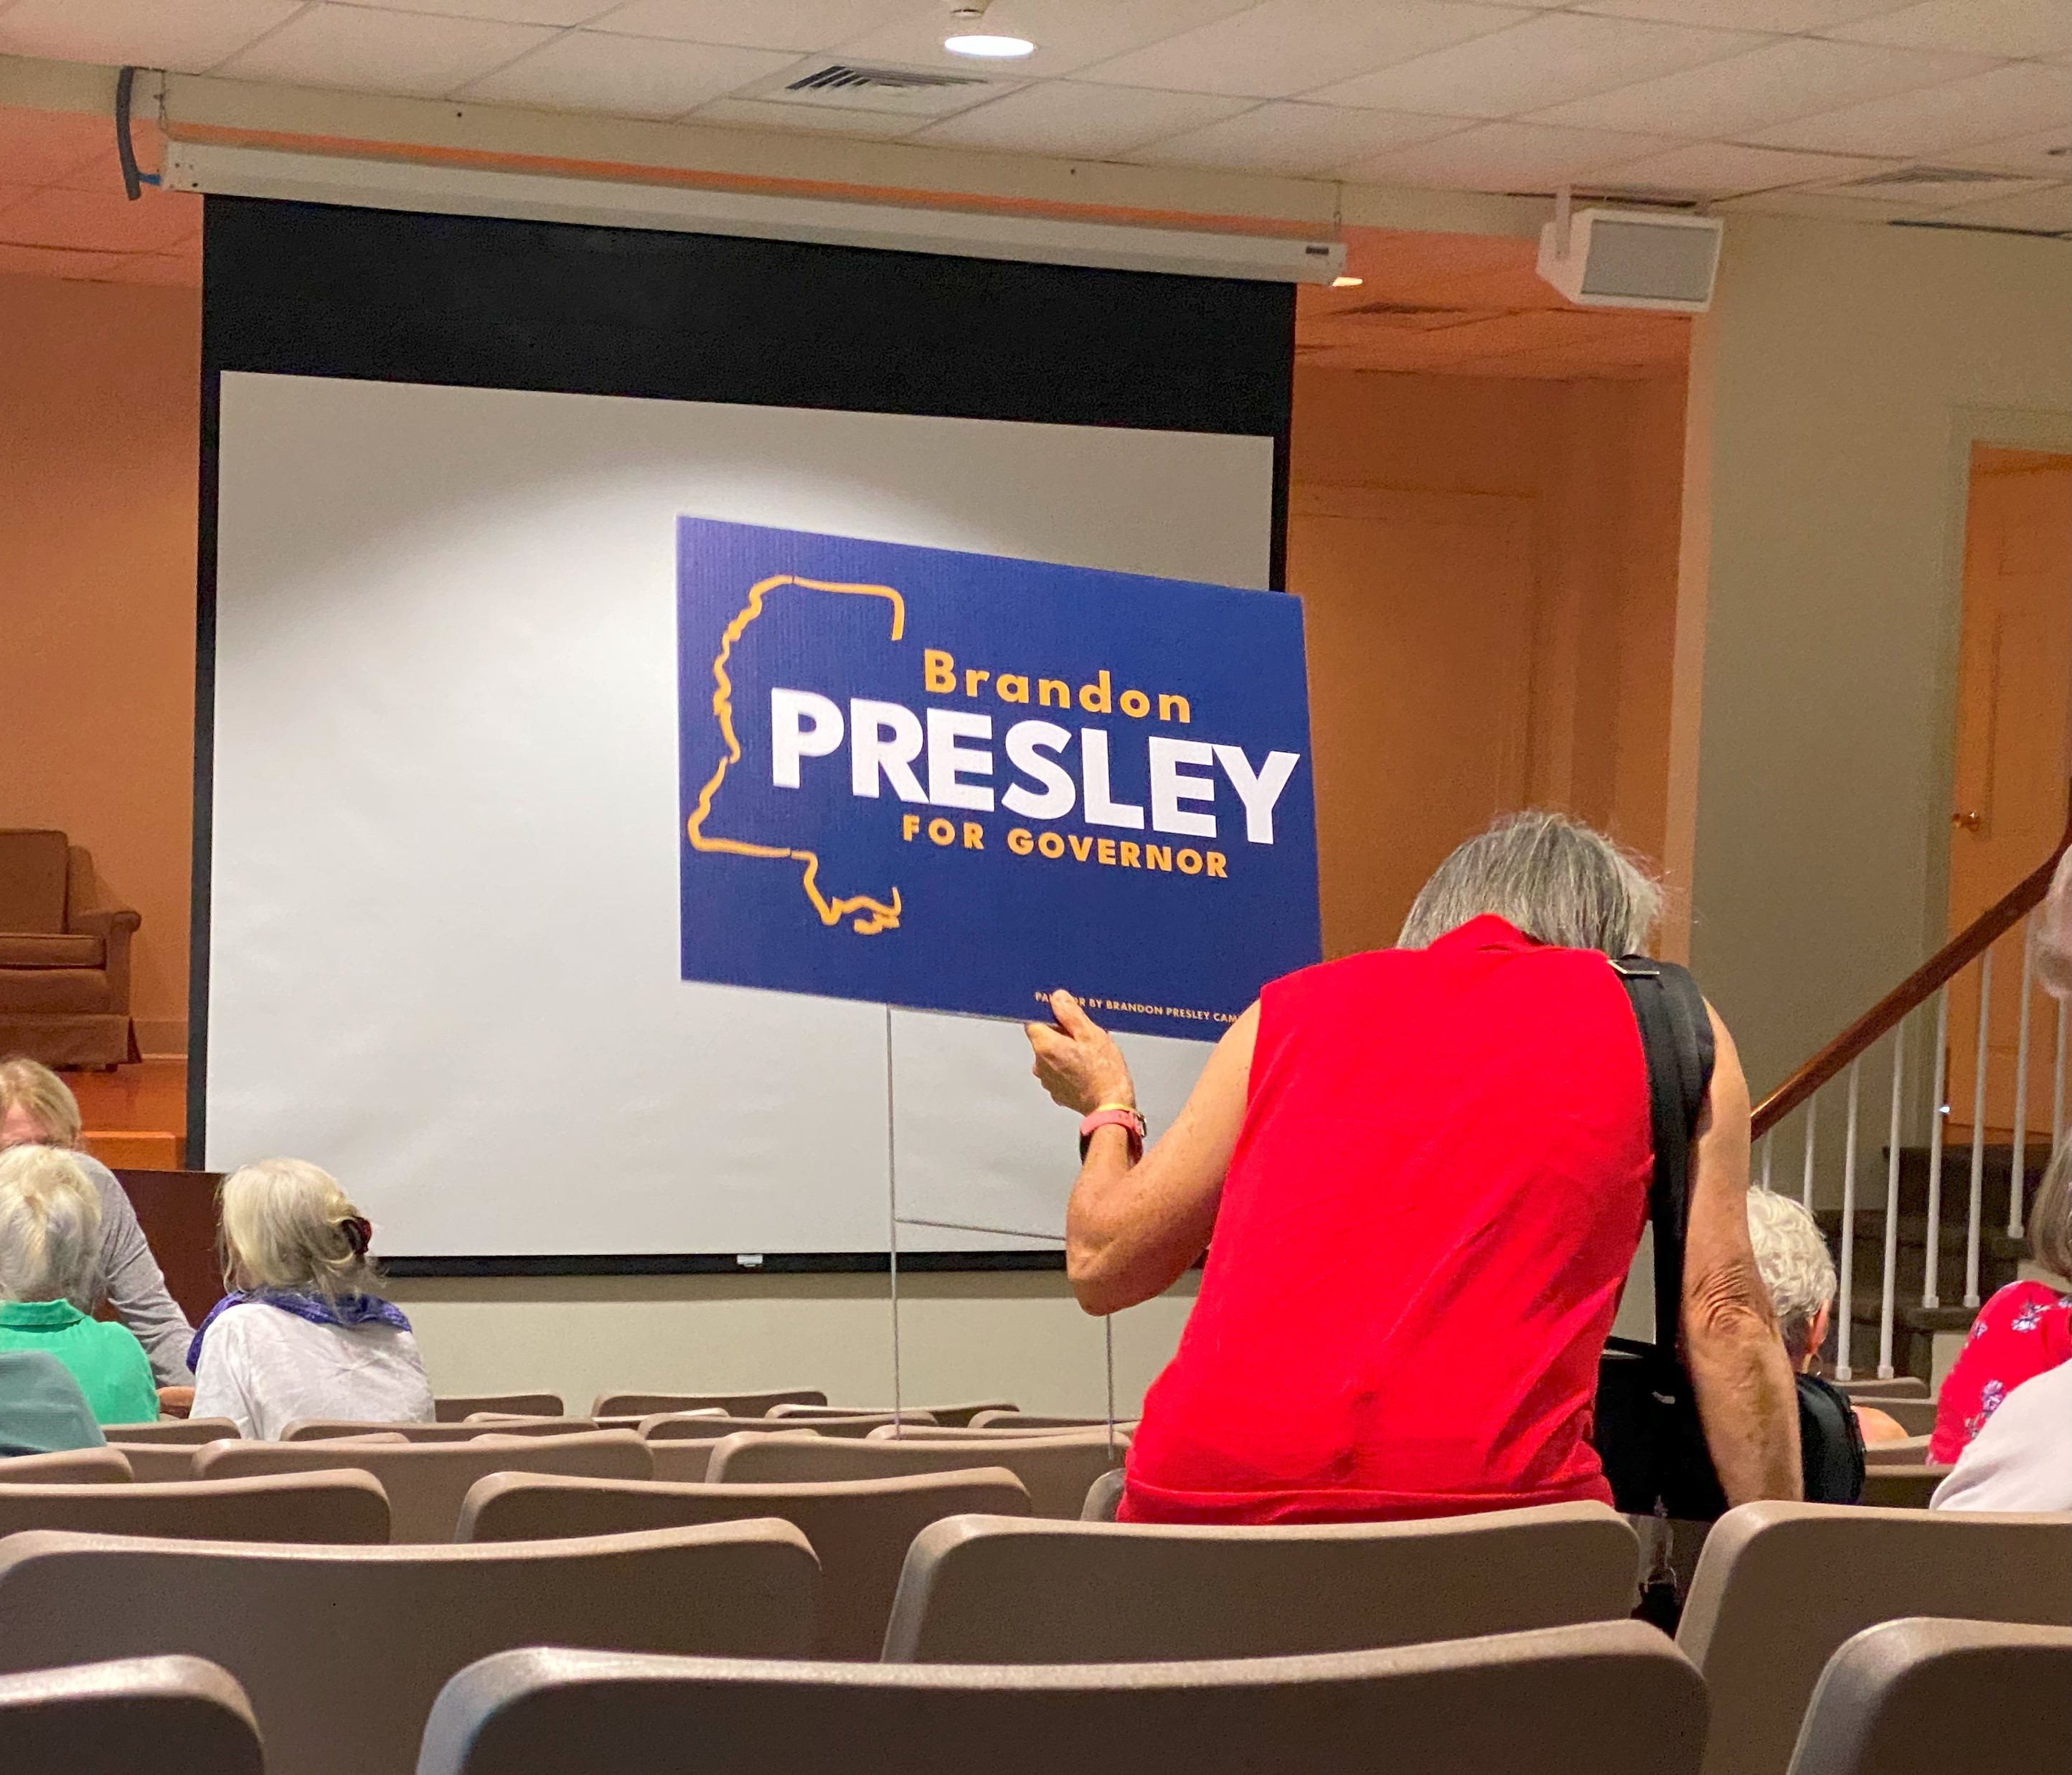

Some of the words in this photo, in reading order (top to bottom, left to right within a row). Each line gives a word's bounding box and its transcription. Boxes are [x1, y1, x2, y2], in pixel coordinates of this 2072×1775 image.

[923, 648, 1191, 723] Brandon
[771, 686, 1301, 845] PRESLEY
[902, 814, 984, 850] FOR
[1007, 827, 1228, 878] GOVERNOR
[1088, 998, 1102, 1009] BY
[1106, 999, 1163, 1015] BRANDON
[1166, 1007, 1210, 1020] PRESLEY
[1212, 1012, 1239, 1024] CAM
